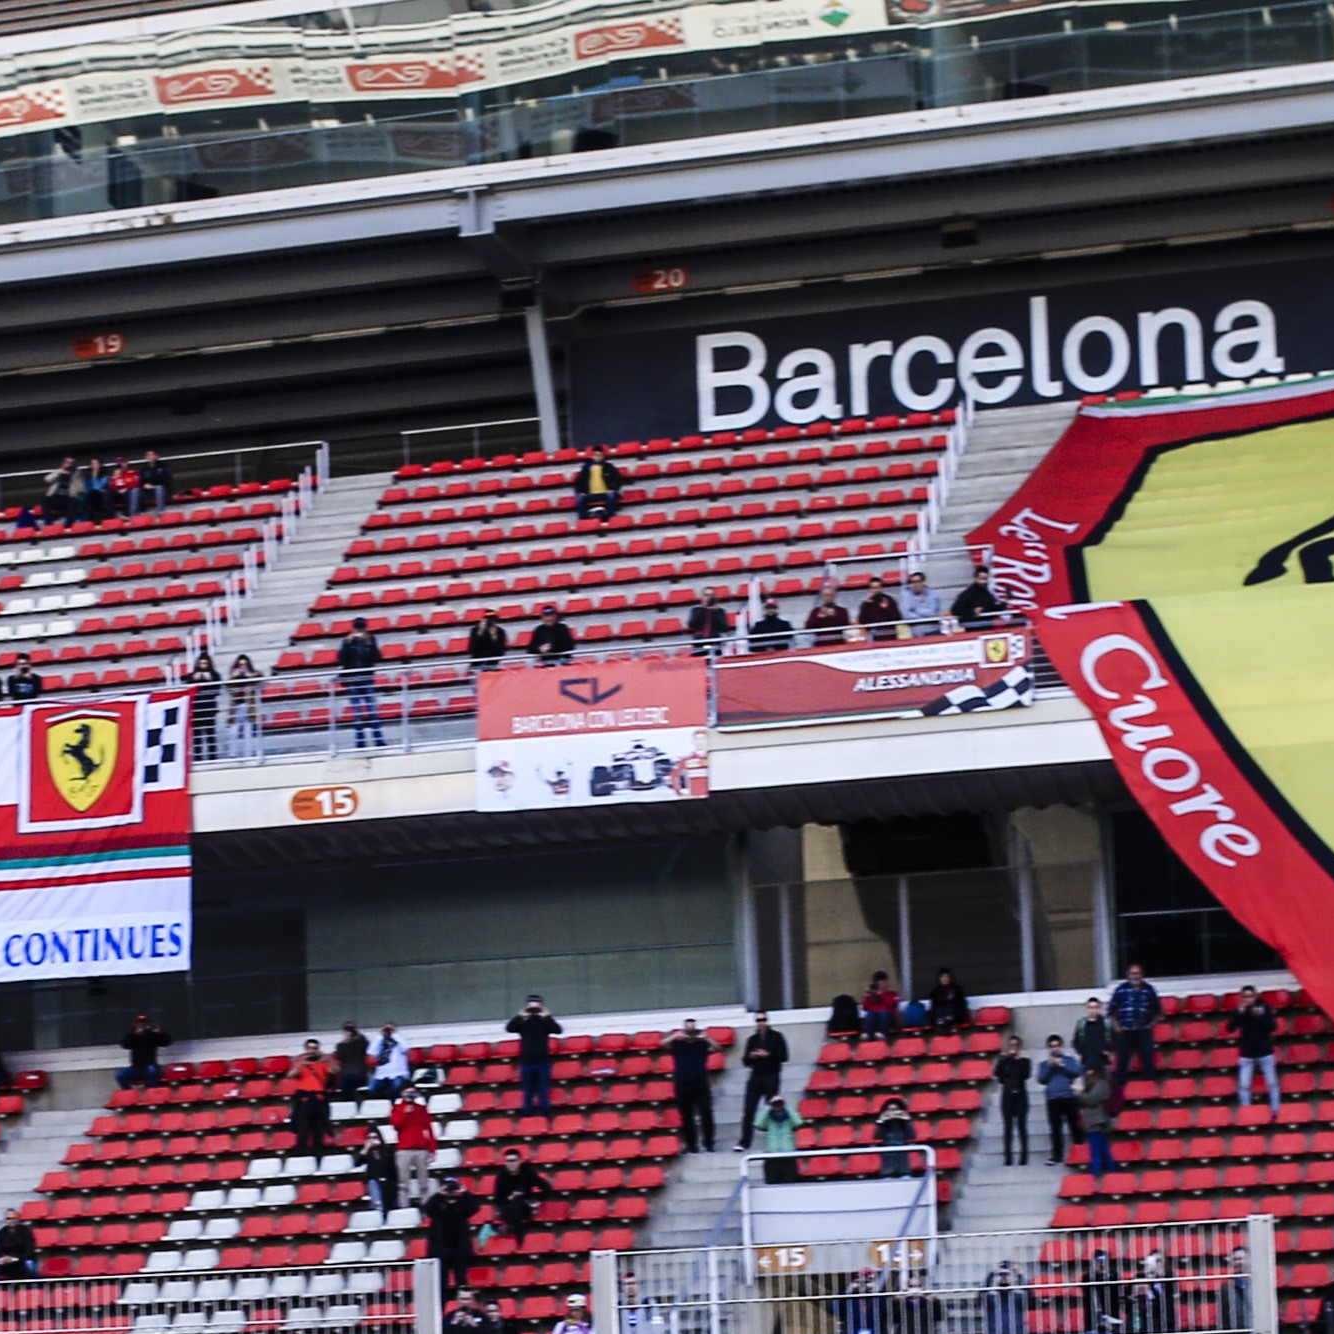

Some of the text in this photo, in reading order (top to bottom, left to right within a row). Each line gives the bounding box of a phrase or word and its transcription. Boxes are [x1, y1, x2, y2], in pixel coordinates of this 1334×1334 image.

[653, 268, 685, 289] 20
[94, 334, 123, 354] 19
[695, 296, 1286, 432] Barcelona
[852, 667, 976, 694] ALESSANDRIA
[1079, 633, 1262, 868] Cuore
[314, 789, 355, 816] 15
[4, 922, 184, 968] CONTINUES
